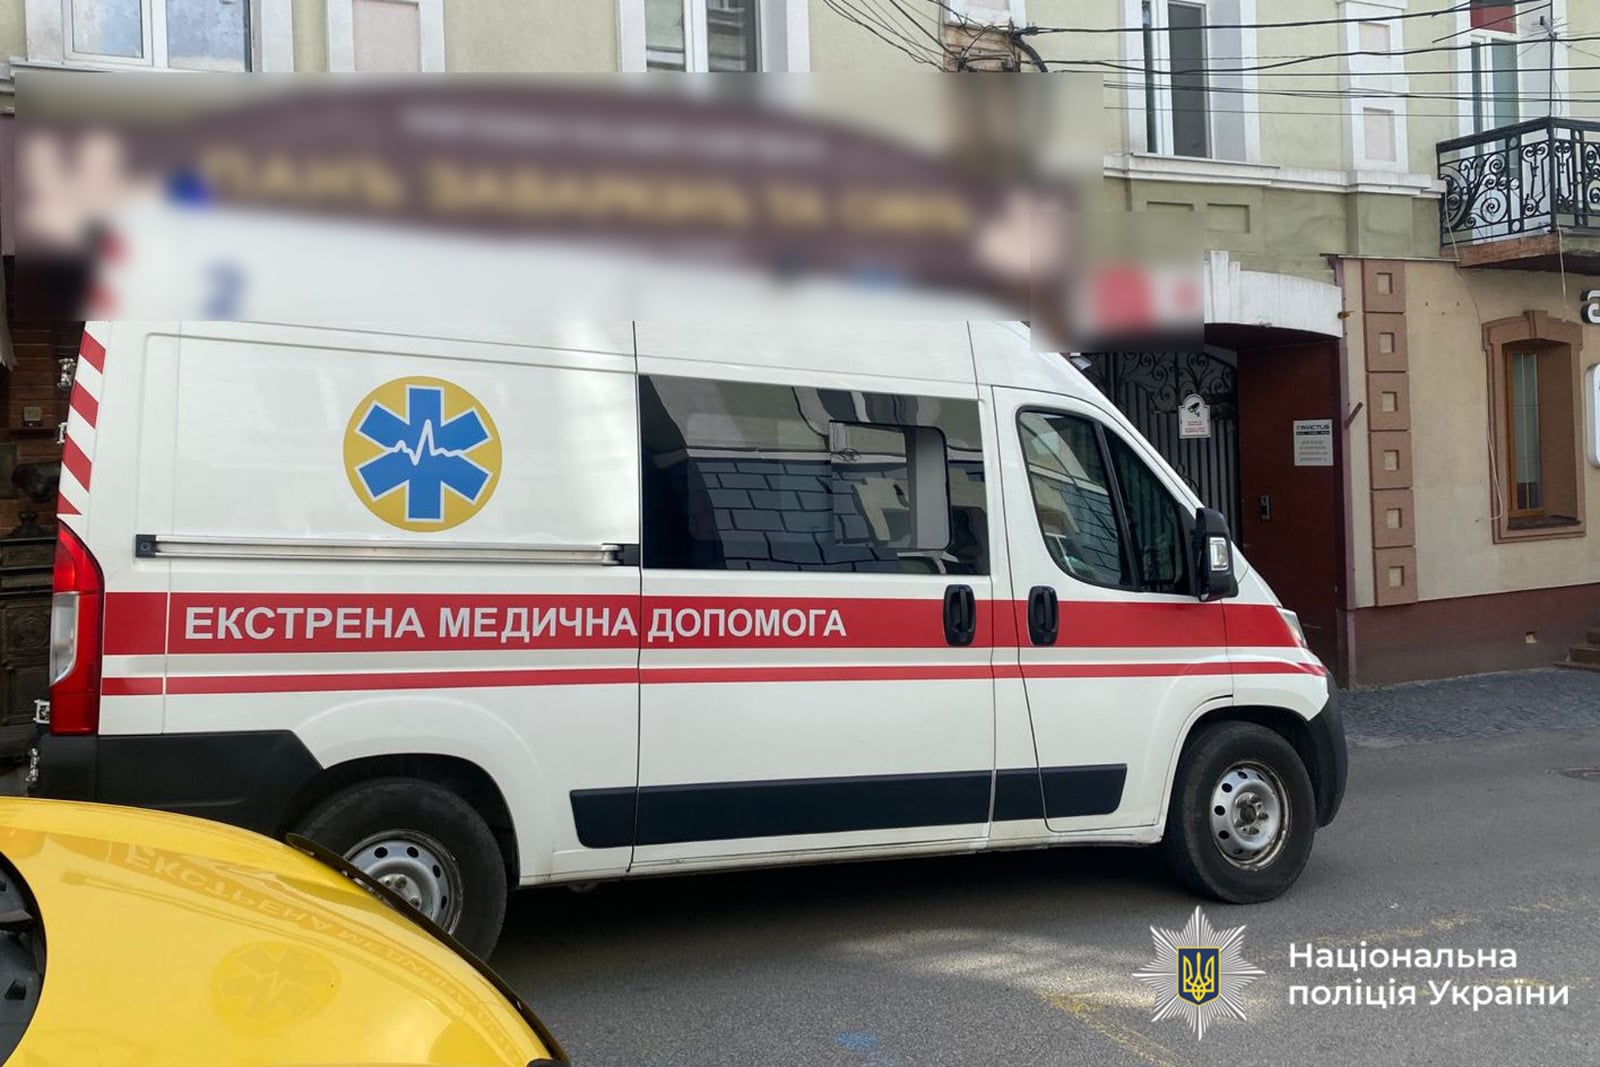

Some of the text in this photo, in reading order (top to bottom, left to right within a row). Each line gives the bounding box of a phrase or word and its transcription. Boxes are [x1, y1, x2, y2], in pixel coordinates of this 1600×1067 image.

[185, 606, 847, 644] ЕКСТРЕНА МЕДИЧНА ДОПОМОГА
